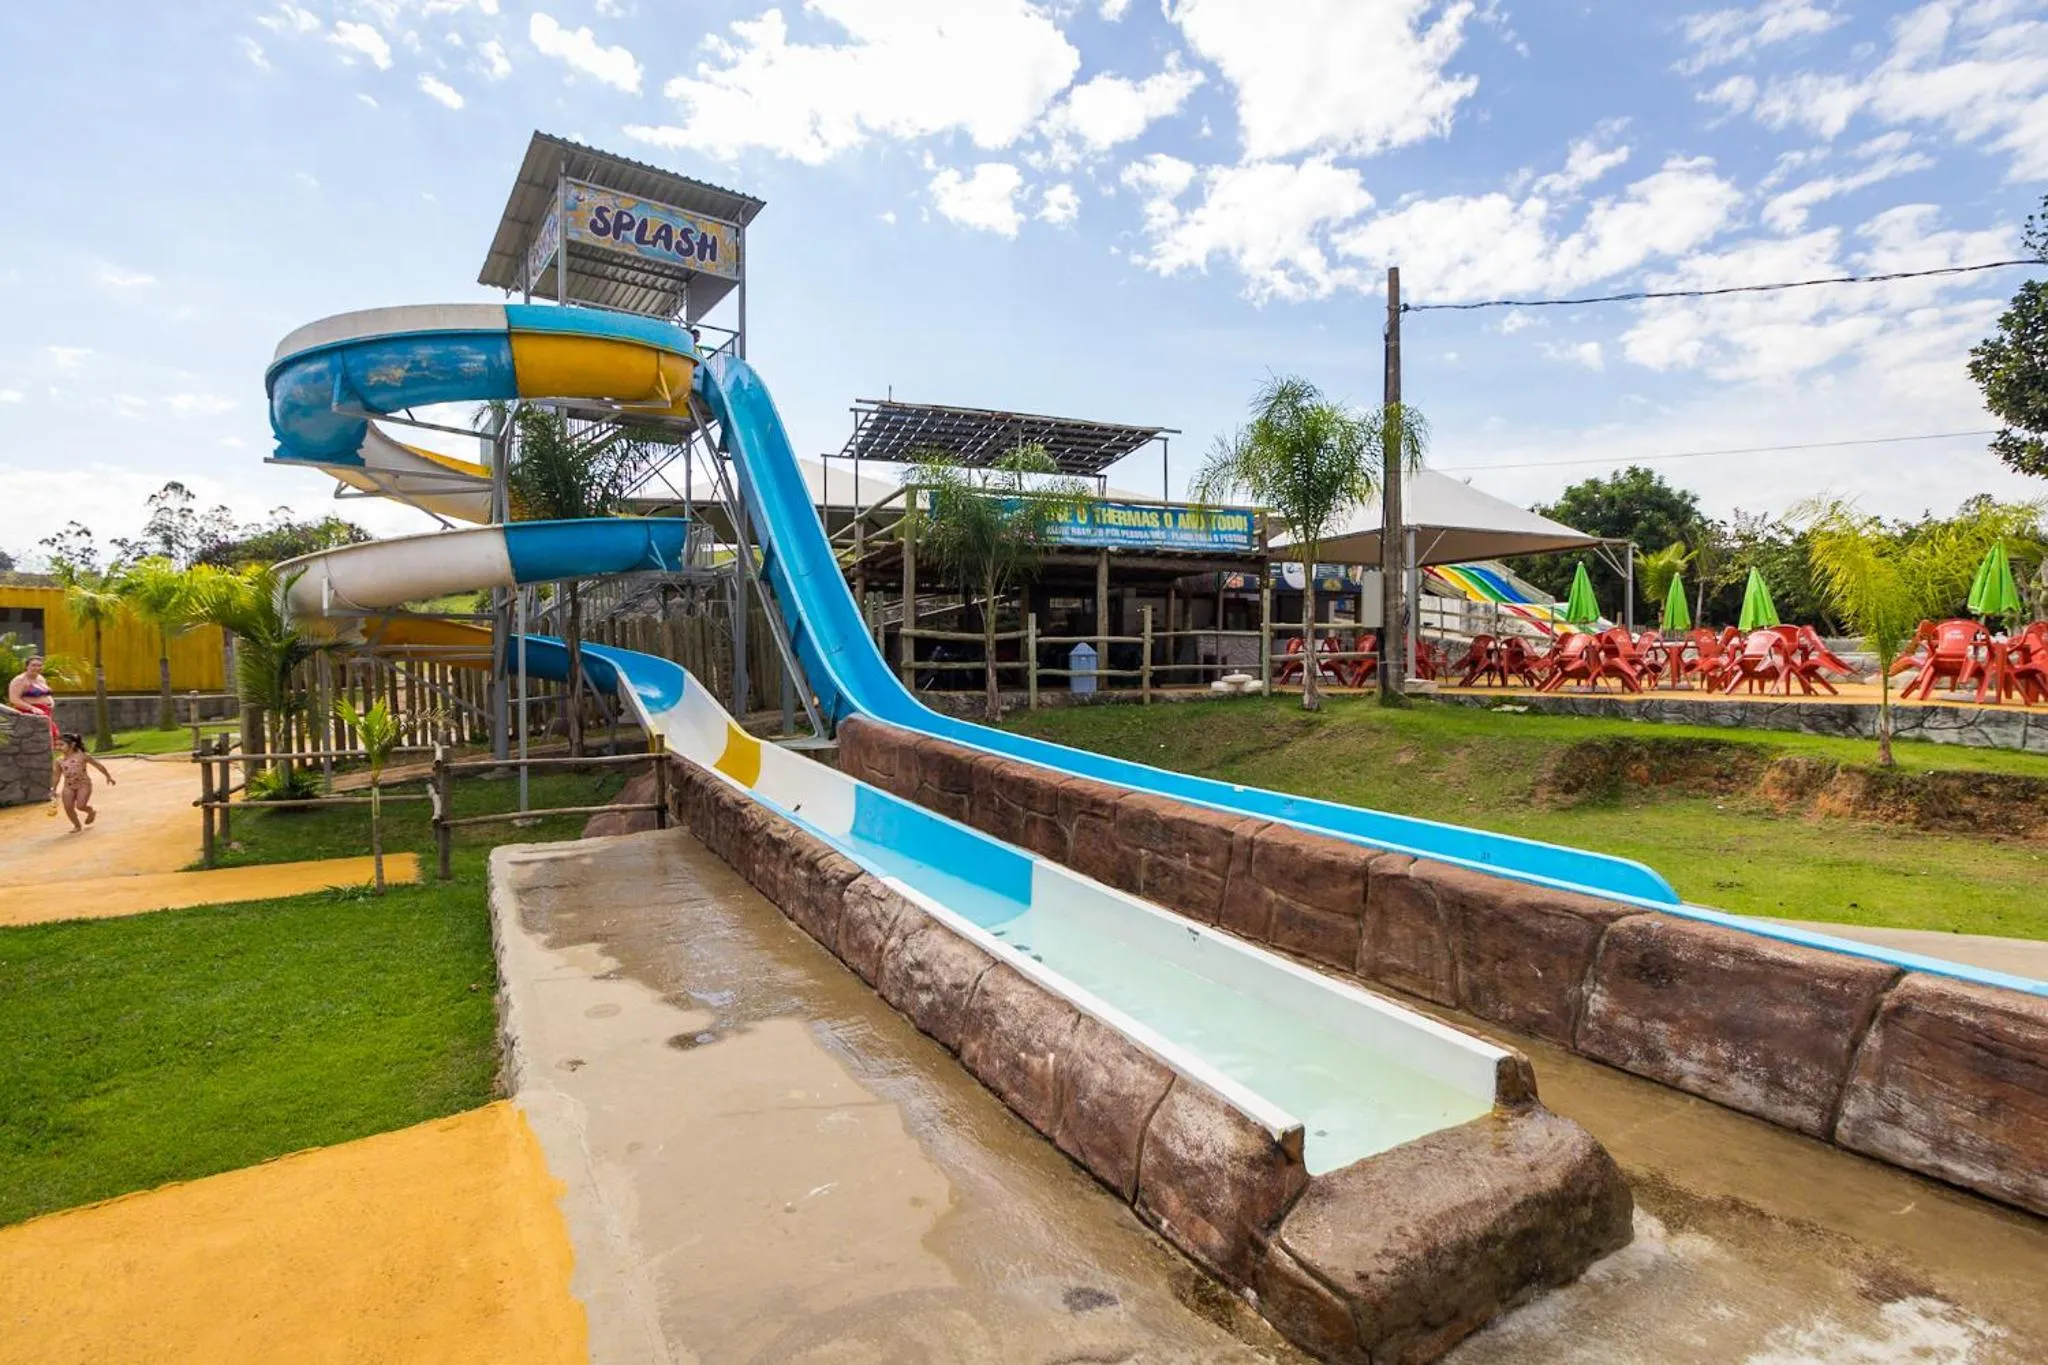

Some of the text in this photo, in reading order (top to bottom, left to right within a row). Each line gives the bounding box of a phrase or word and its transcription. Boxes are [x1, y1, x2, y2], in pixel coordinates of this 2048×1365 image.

[589, 205, 718, 262] SPLASH
[1093, 507, 1160, 528] THERMAS
[1163, 512, 1174, 529] O
